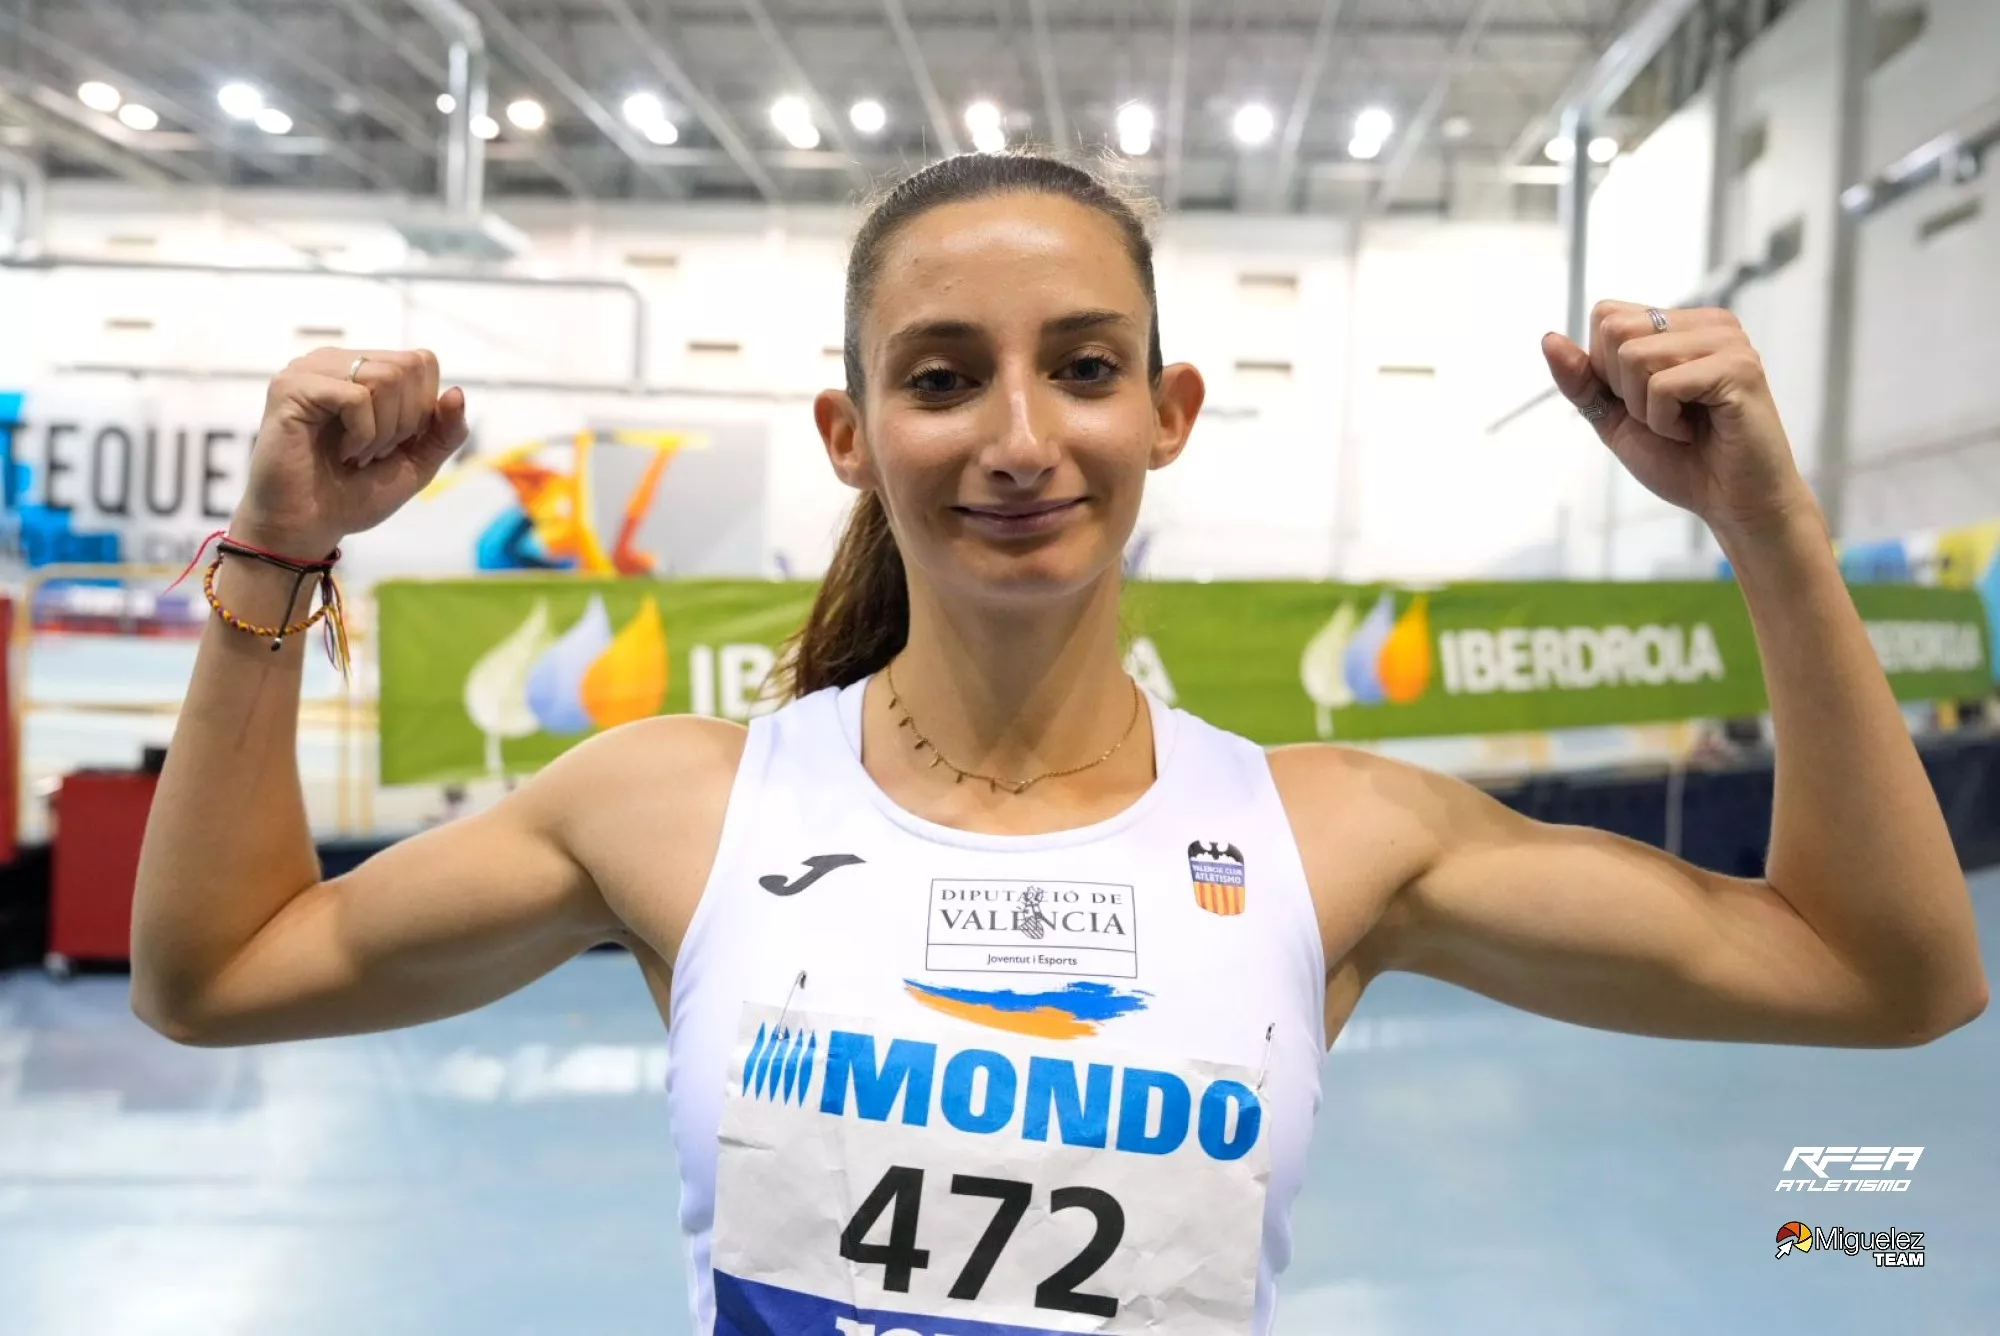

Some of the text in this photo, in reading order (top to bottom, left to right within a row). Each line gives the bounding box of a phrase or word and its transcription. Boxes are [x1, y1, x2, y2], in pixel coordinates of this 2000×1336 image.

[0, 421, 258, 519] TEQUE
[1438, 621, 1725, 693] IBERDROLA
[1092, 892, 1123, 905] DE
[1195, 873, 1241, 884] ATLETISMO
[987, 953, 1077, 966] Joventut i Esports
[819, 1030, 1262, 1161] MONDO
[839, 1165, 1126, 1319] 472
